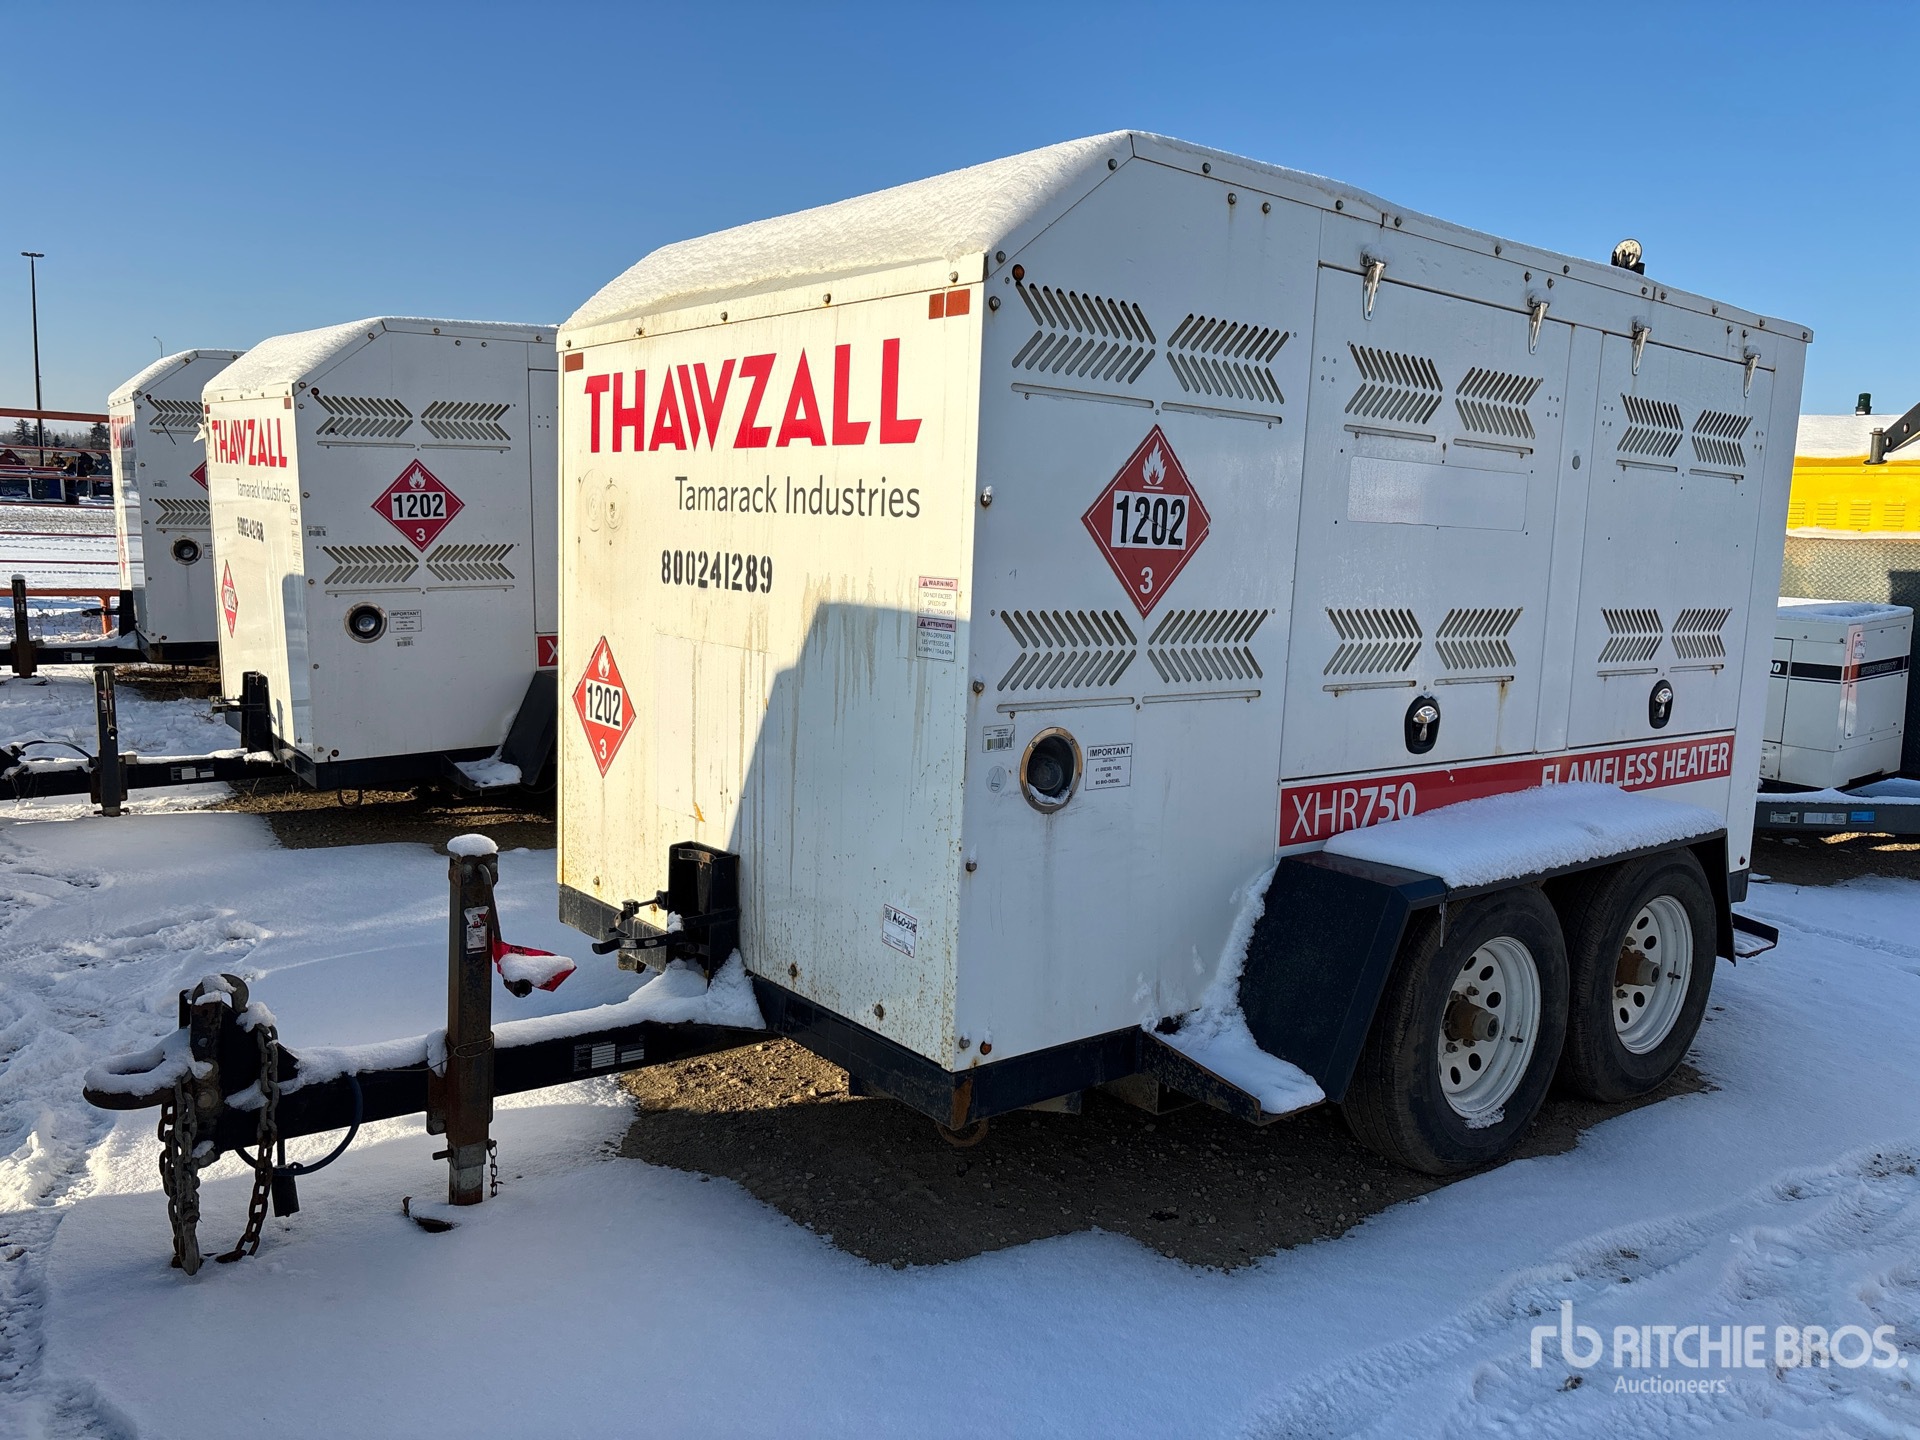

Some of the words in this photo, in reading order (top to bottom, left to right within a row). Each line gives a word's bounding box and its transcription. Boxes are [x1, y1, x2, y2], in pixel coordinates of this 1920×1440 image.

[584, 338, 922, 453] THAWZALL
[212, 418, 287, 468] THAWZALL
[236, 478, 260, 499] Tamarack
[261, 480, 290, 503] Industries
[393, 493, 444, 518] 1202
[675, 475, 777, 513] Tamarack
[786, 475, 920, 518] Industries
[416, 528, 426, 541] 3
[1115, 495, 1186, 545] 1202
[661, 549, 773, 594] 800241289
[928, 580, 954, 588] WARNING
[1139, 566, 1153, 594] 3
[927, 621, 953, 629] ATTENTION
[587, 683, 621, 727] 1202
[599, 738, 607, 760] 3
[1090, 746, 1130, 757] IMPORTANT
[1662, 742, 1730, 781] HEATER
[1290, 781, 1417, 839] XHR750
